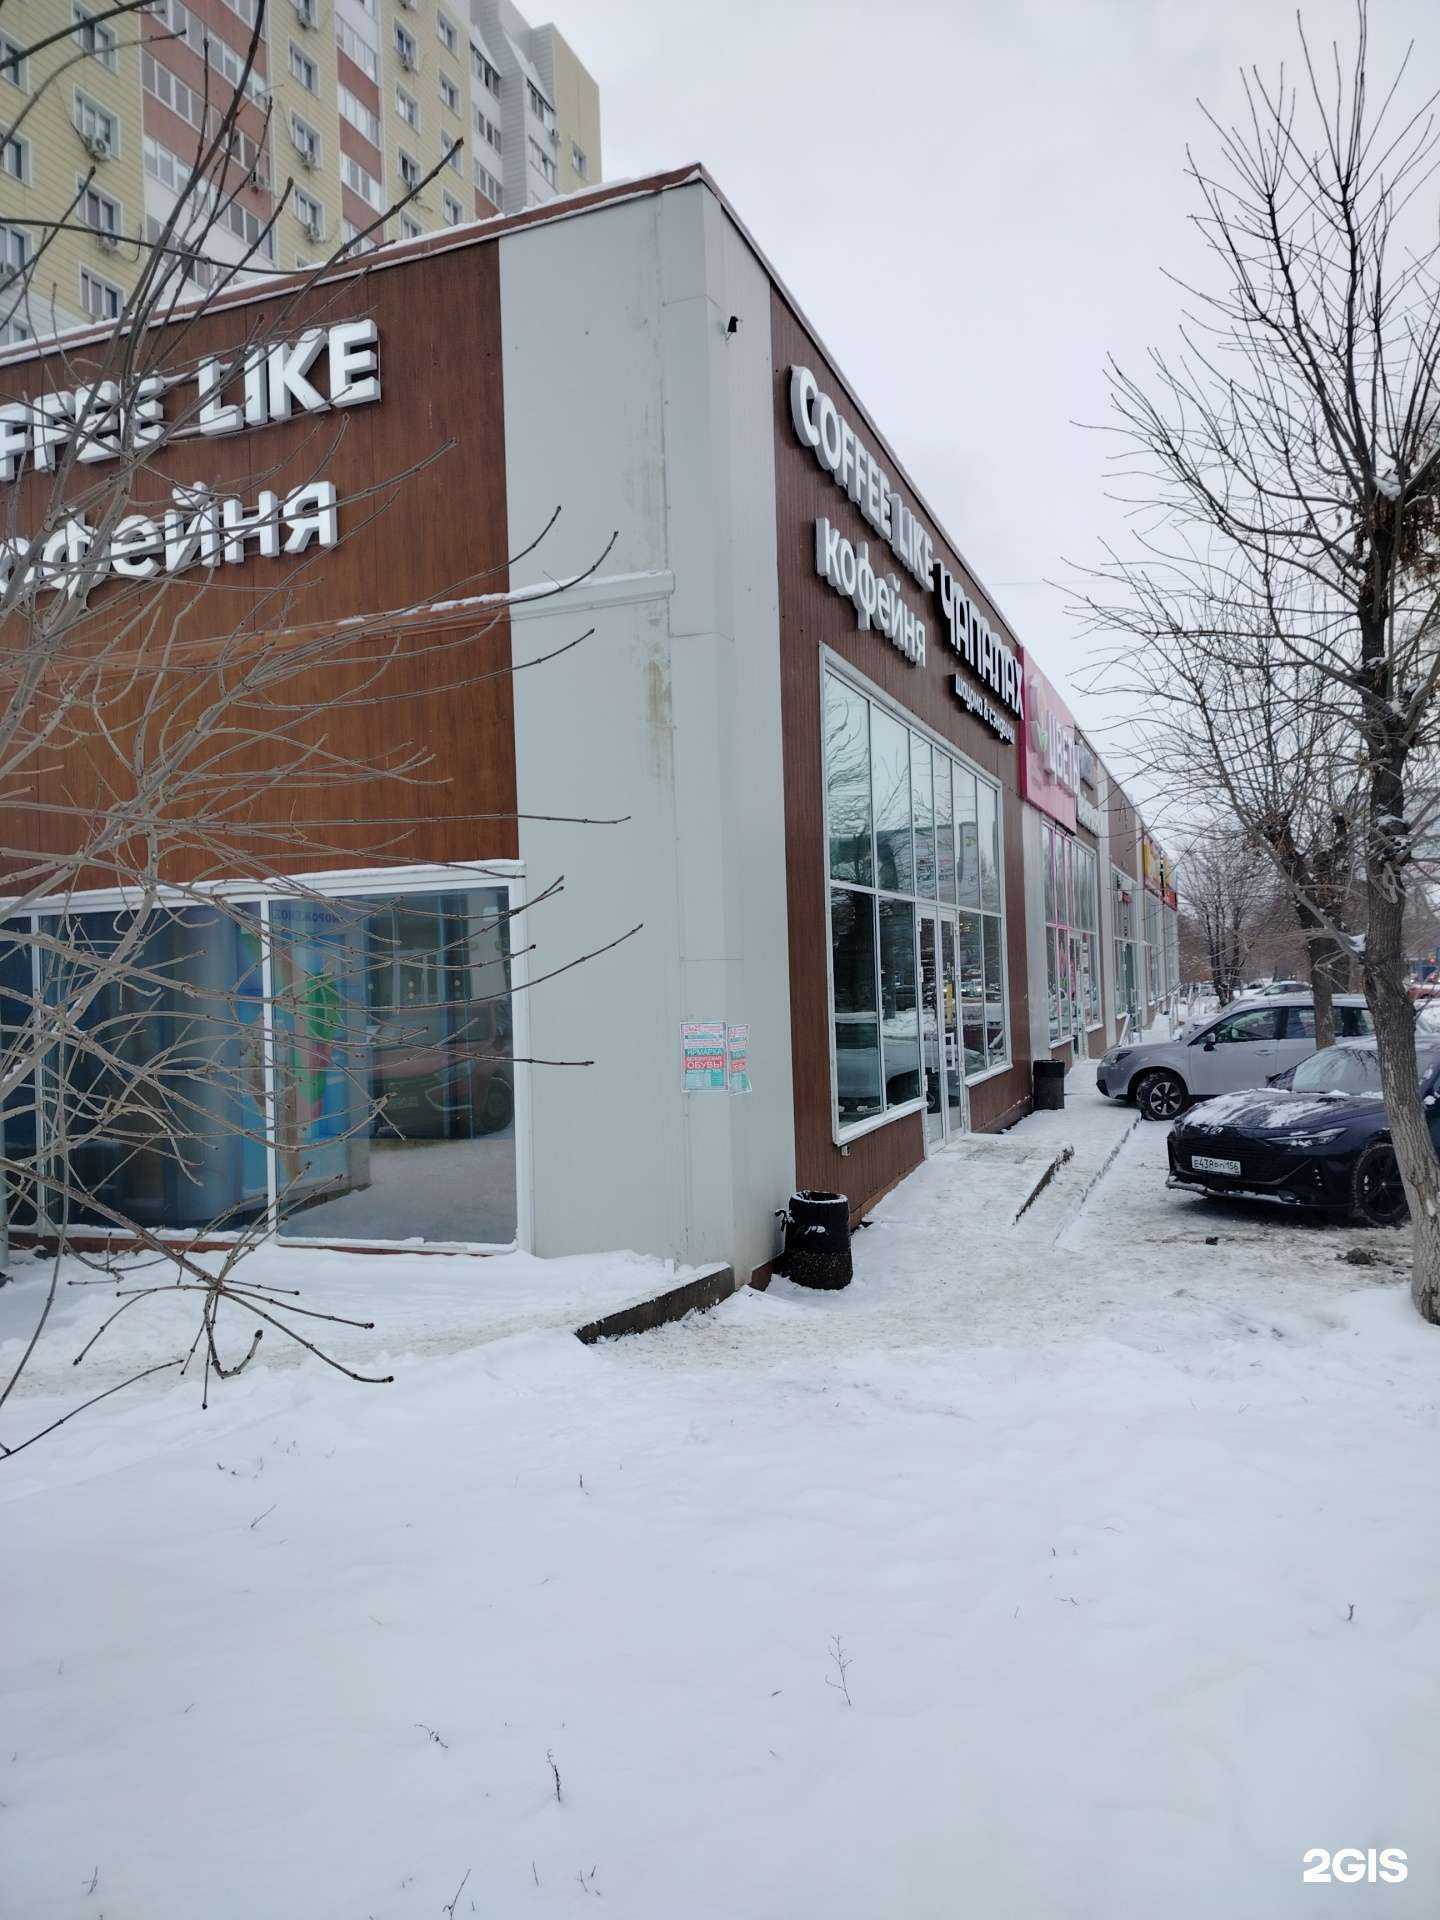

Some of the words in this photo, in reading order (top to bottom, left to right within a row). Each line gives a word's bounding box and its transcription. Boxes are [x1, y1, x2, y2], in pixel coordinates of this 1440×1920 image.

[198, 318, 381, 436] LIKE
[789, 364, 893, 542] COFFEE
[887, 492, 935, 592] LIKE
